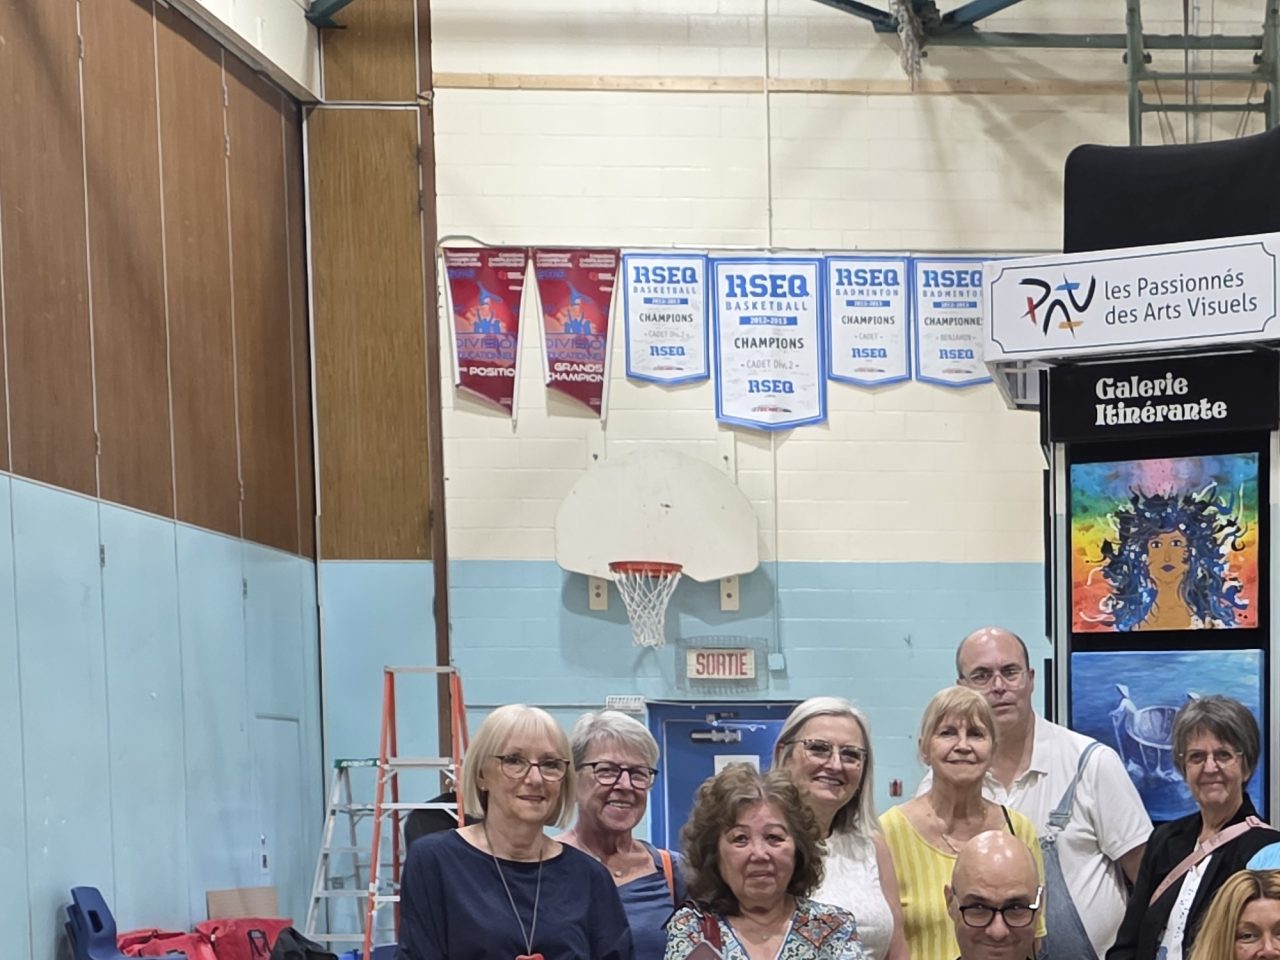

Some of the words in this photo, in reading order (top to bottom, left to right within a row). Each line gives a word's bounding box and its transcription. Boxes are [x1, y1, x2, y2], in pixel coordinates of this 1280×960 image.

[633, 266, 698, 284] RSEQ
[835, 268, 900, 287] RSEQ
[922, 270, 982, 288] RSEQ
[725, 274, 810, 298] RSEQ
[1104, 281, 1131, 301] les
[1137, 268, 1245, 298] Passionnés
[633, 286, 697, 295] BASKETBALL
[835, 288, 899, 297] BADMINTON
[922, 289, 982, 298] BADMINTO
[725, 301, 808, 311] BASKETBALL
[1104, 306, 1138, 325] des
[1144, 301, 1182, 321] Arts
[1187, 292, 1258, 319] Visuels
[639, 313, 694, 323] CHAMPIONS
[841, 315, 896, 325] CHAMPIONS
[924, 317, 983, 326] CHAMPIONNE
[734, 337, 804, 349] CHAMPIONS
[650, 346, 686, 356] RSEQ
[851, 347, 888, 358] RSEQ
[939, 349, 974, 360] RSEQ
[469, 366, 516, 377] POSITIO
[554, 362, 603, 374] GRANDS
[547, 372, 605, 383] HAMPION
[747, 379, 795, 394] RSEQ
[1095, 372, 1189, 400] Galerie
[1095, 398, 1228, 426] Itinérante
[695, 653, 748, 676] SORTIE
